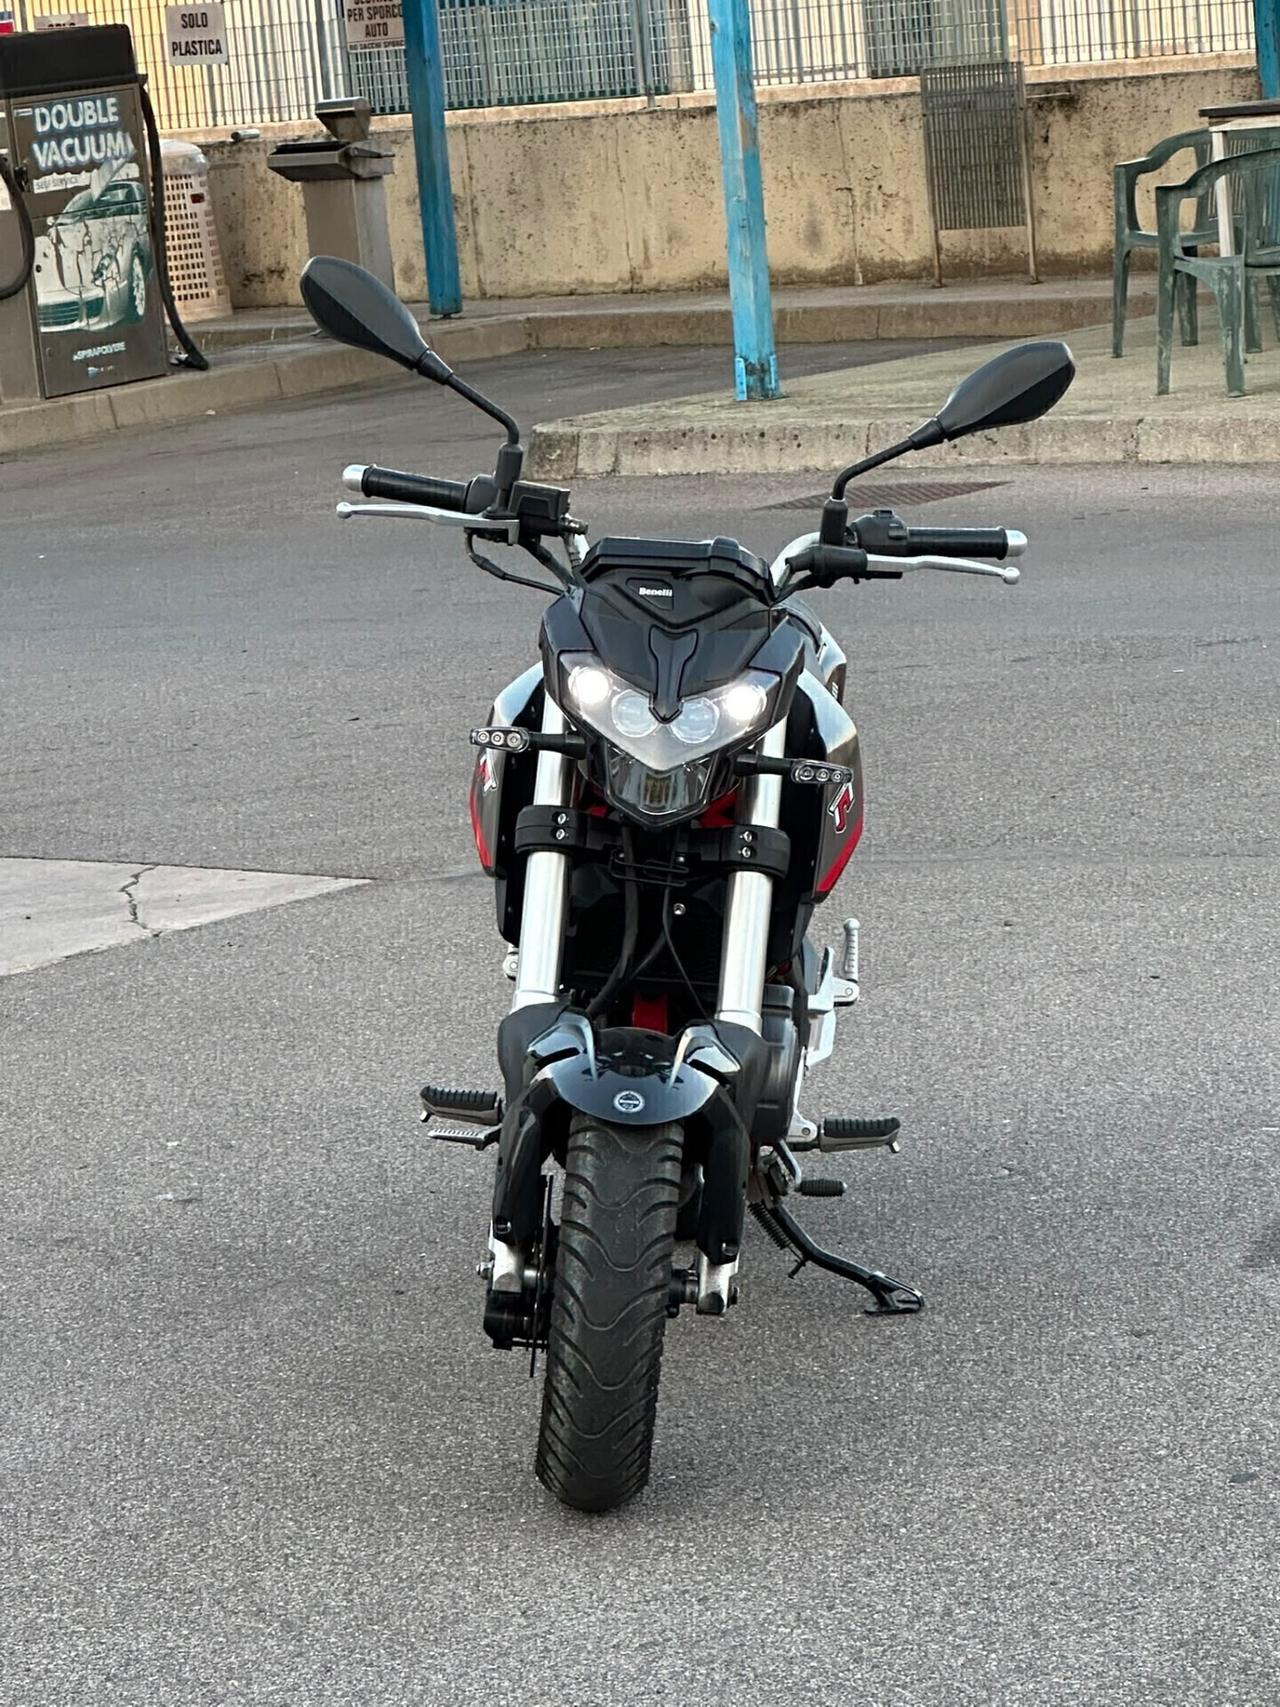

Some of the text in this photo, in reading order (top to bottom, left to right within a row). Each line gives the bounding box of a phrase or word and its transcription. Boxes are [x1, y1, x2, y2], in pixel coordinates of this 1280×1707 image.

[181, 12, 208, 28] SOLO
[347, 7, 364, 22] PER
[365, 22, 388, 38] AUTO
[172, 39, 222, 56] PLASTICA
[34, 97, 119, 133] DOUBLE
[639, 587, 673, 597] Benelli
